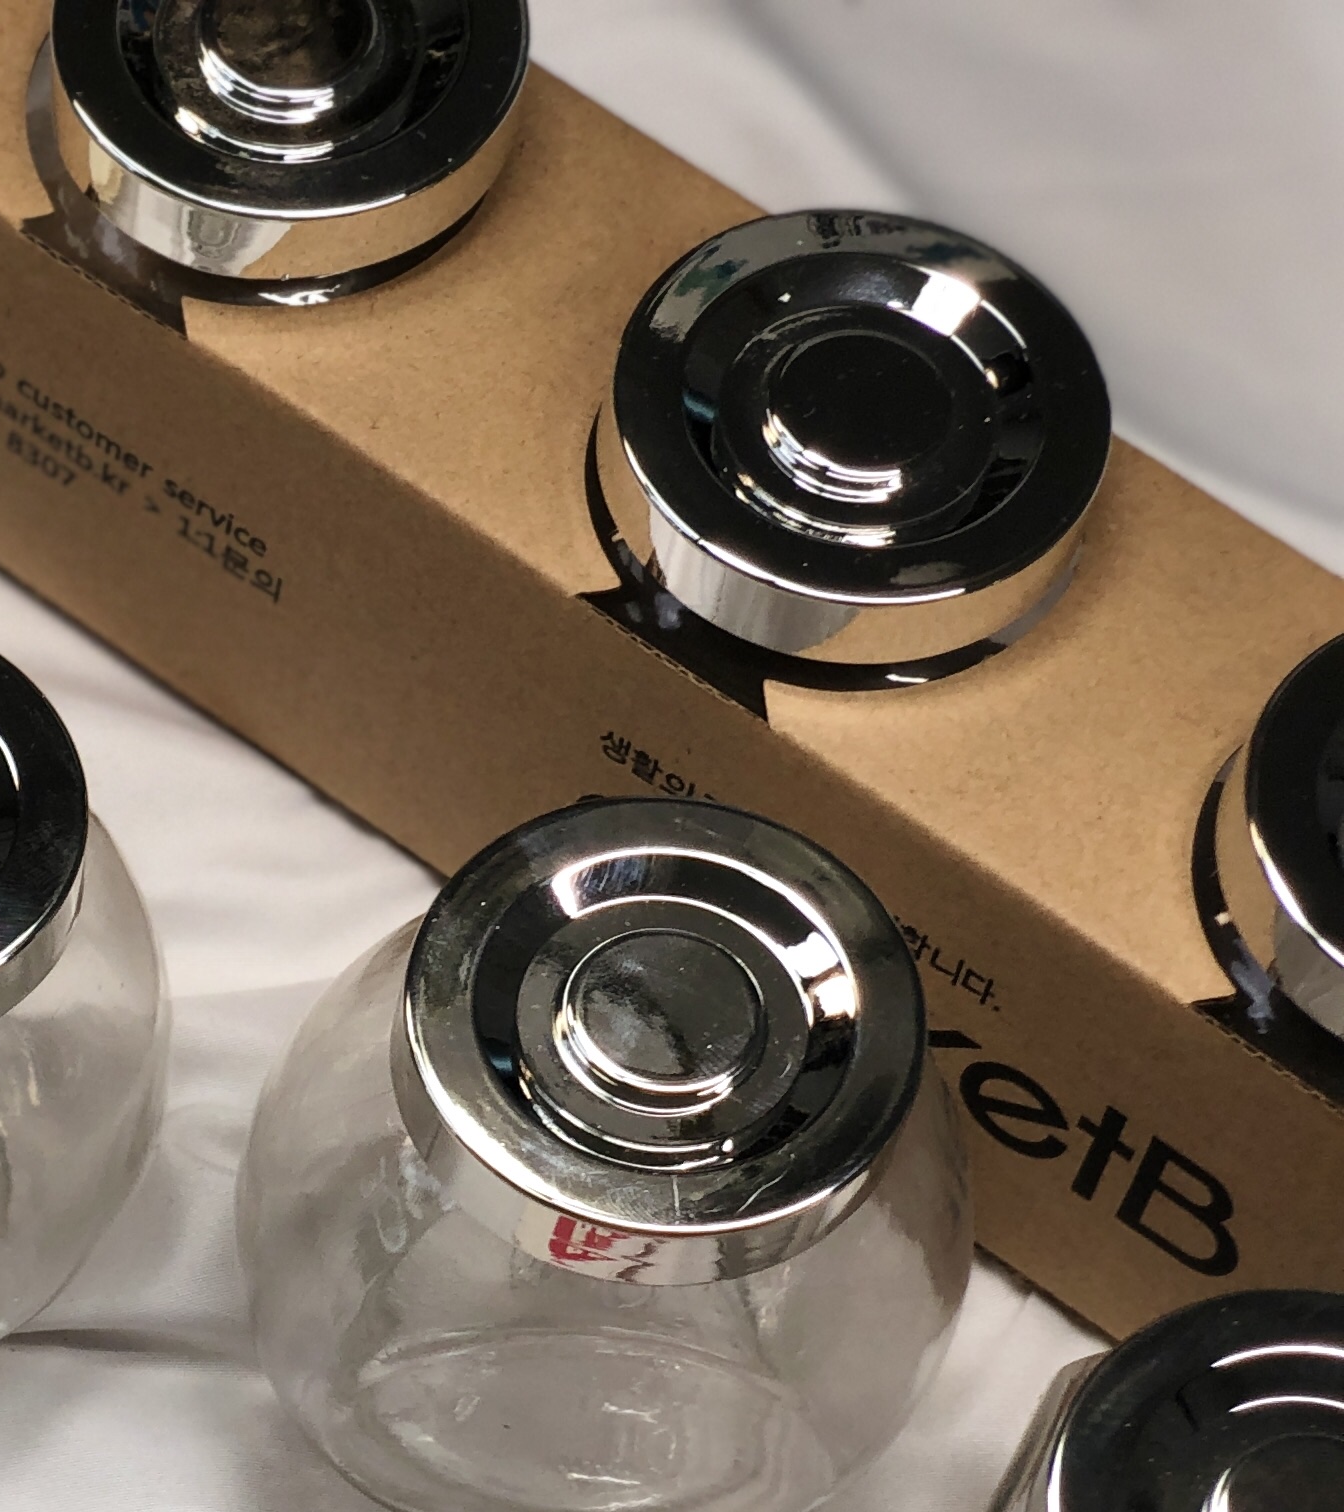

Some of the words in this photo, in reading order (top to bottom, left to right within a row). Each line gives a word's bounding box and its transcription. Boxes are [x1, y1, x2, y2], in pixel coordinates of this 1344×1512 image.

[16, 376, 153, 479] customer
[163, 475, 268, 559] service
[927, 1030, 1239, 1276] etB
